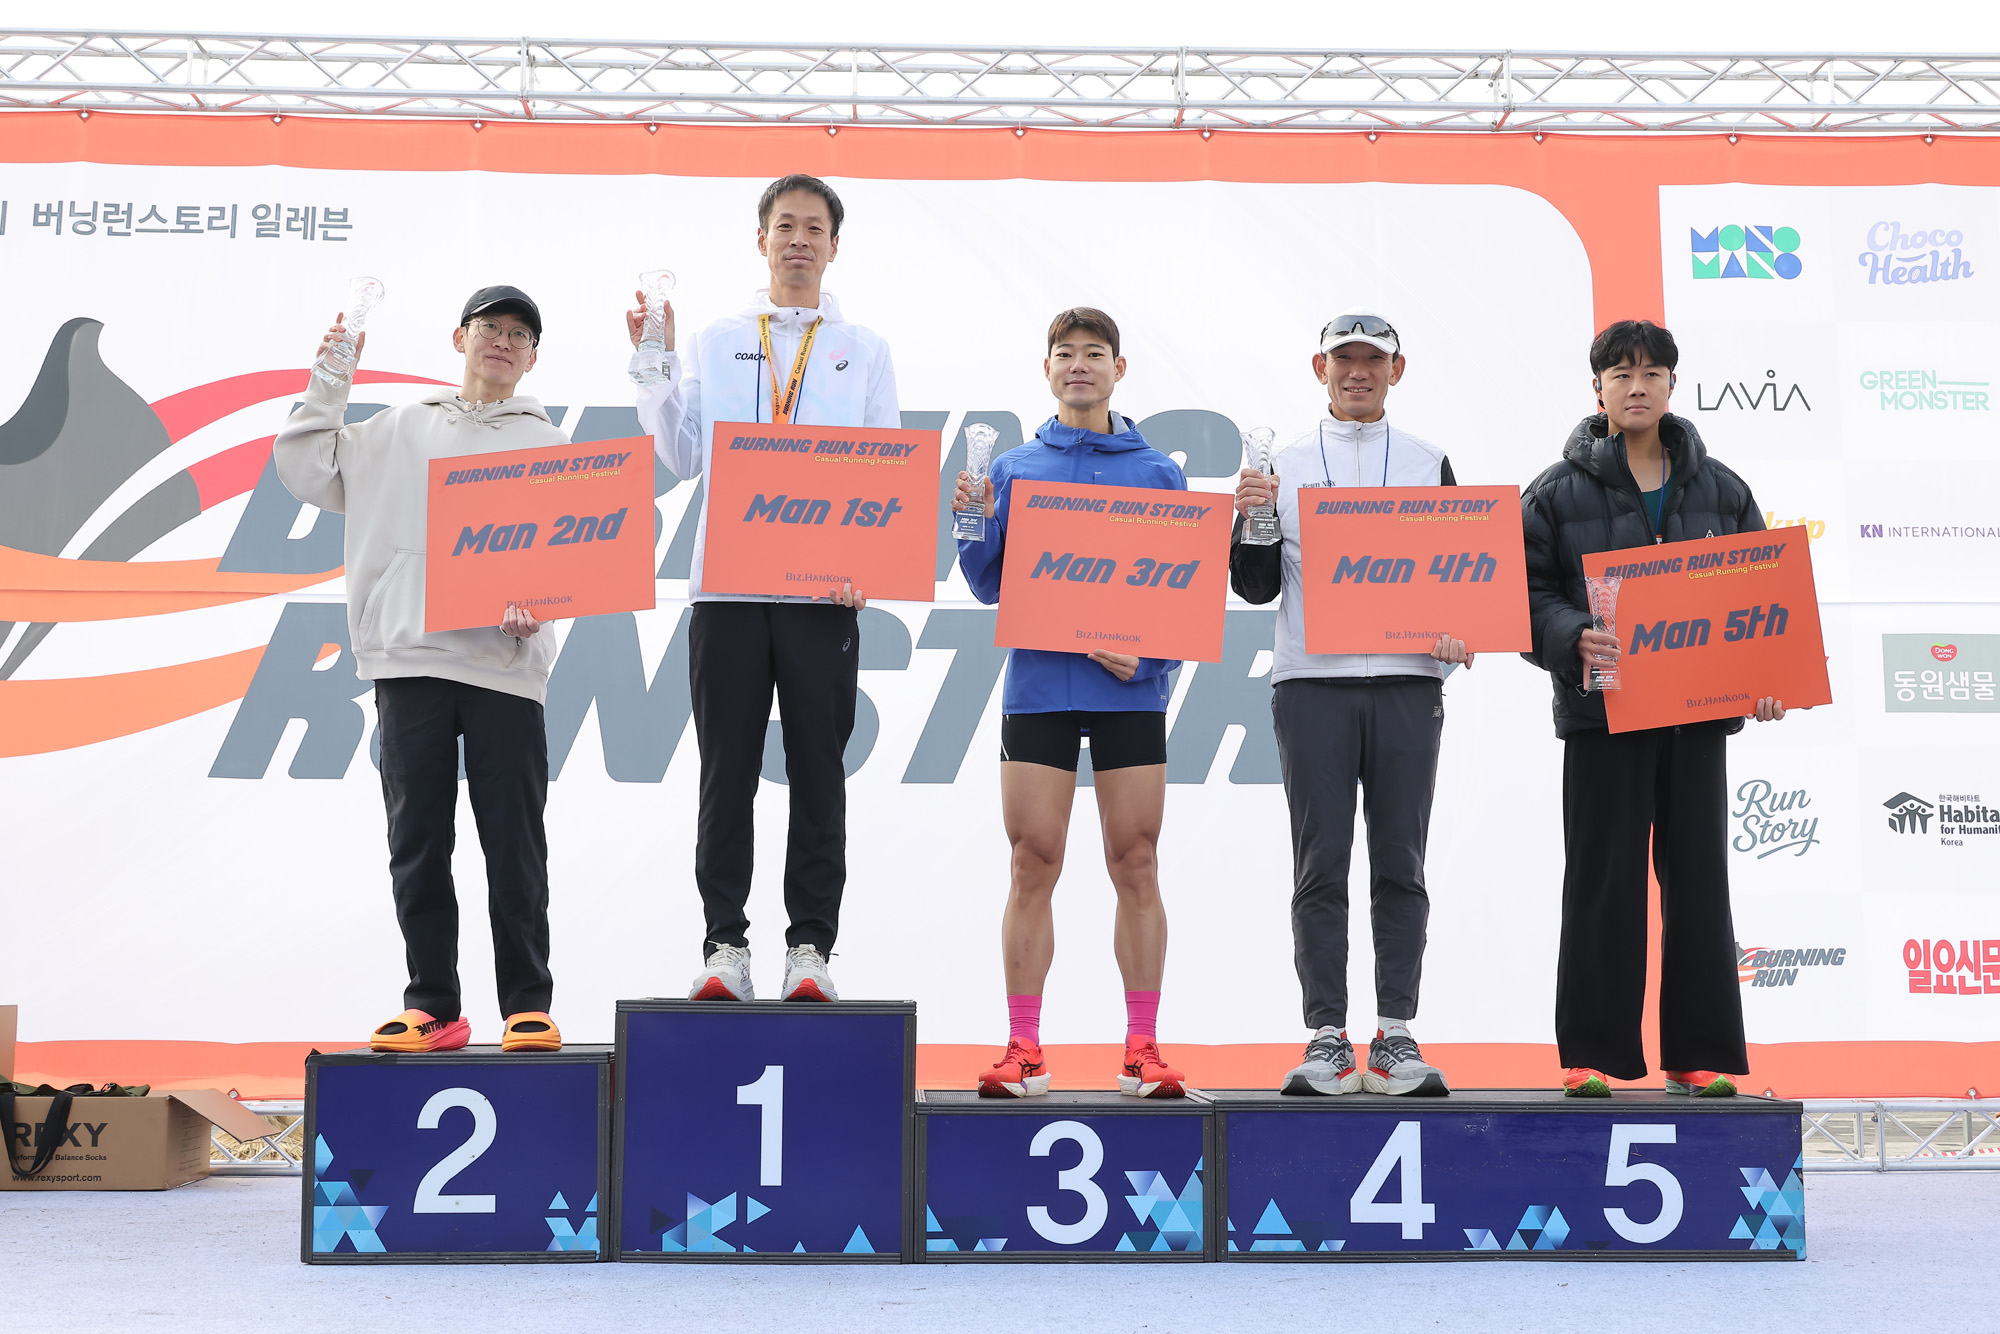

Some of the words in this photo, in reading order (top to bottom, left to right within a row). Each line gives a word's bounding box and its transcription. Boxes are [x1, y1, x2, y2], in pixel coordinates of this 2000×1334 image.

[32, 200, 238, 239] 버닝런스토리
[250, 203, 353, 242] 일레븐
[1866, 221, 1964, 252] Choco
[1858, 248, 1975, 285] Health
[735, 352, 767, 362] COACH
[782, 390, 794, 416] BURNING
[789, 378, 798, 391] RUN
[794, 356, 805, 375] Casual
[800, 335, 812, 356] Running
[1859, 370, 1937, 390] GREEN
[1880, 390, 1990, 411] MONSTER
[729, 436, 812, 454] BURNING
[814, 440, 855, 456] RUN
[855, 441, 919, 458] STORY
[814, 455, 841, 464] Casual
[843, 457, 875, 466] Running
[877, 457, 907, 466] Festival
[444, 463, 526, 486] BURNING
[528, 459, 568, 477] RUN
[569, 452, 632, 472] STORY
[529, 476, 555, 485] Casual
[557, 472, 589, 483] Running
[591, 469, 621, 479] Festival
[742, 493, 832, 526] Man
[840, 497, 903, 528] 1st
[1026, 494, 1108, 513] BURNING
[1108, 499, 1149, 516] RUN
[1149, 503, 1212, 520] STORY
[1315, 501, 1396, 515] BURNING
[1397, 500, 1438, 514] RUN
[1438, 500, 1499, 513] STORY
[1426, 515, 1458, 523] Running
[451, 523, 538, 556] Man
[547, 507, 628, 546] 2nd
[1109, 515, 1135, 524] Casual
[1136, 517, 1168, 527] Running
[1170, 519, 1199, 528] Festival
[1860, 524, 1883, 538] KN
[1030, 551, 1116, 584] Man
[1125, 558, 1201, 589] 3rd
[1331, 555, 1416, 584] Man
[1427, 552, 1497, 582] 4th
[1686, 552, 1725, 571] RUN
[1727, 543, 1787, 566] STORY
[1688, 570, 1715, 580] Casual
[1716, 566, 1748, 578] Running
[1749, 562, 1779, 572] Festival
[1628, 617, 1711, 655] Man
[1724, 603, 1789, 642] 5th
[1893, 669, 1997, 702] 동원샘물
[1732, 779, 1812, 818] Run
[1939, 794, 1980, 802] 한국해비타트
[1732, 814, 1820, 860] Story
[1940, 824, 1955, 835] for
[1940, 837, 1964, 846] Korea
[1751, 948, 1847, 968] BURNING
[1751, 968, 1799, 988] RUN
[737, 1065, 784, 1187] 1
[413, 1087, 498, 1214] 2
[12, 1174, 102, 1183] www.rexysport.com
[1026, 1120, 1108, 1245] 3
[1349, 1120, 1436, 1240] 4
[1602, 1123, 1684, 1244] 5
